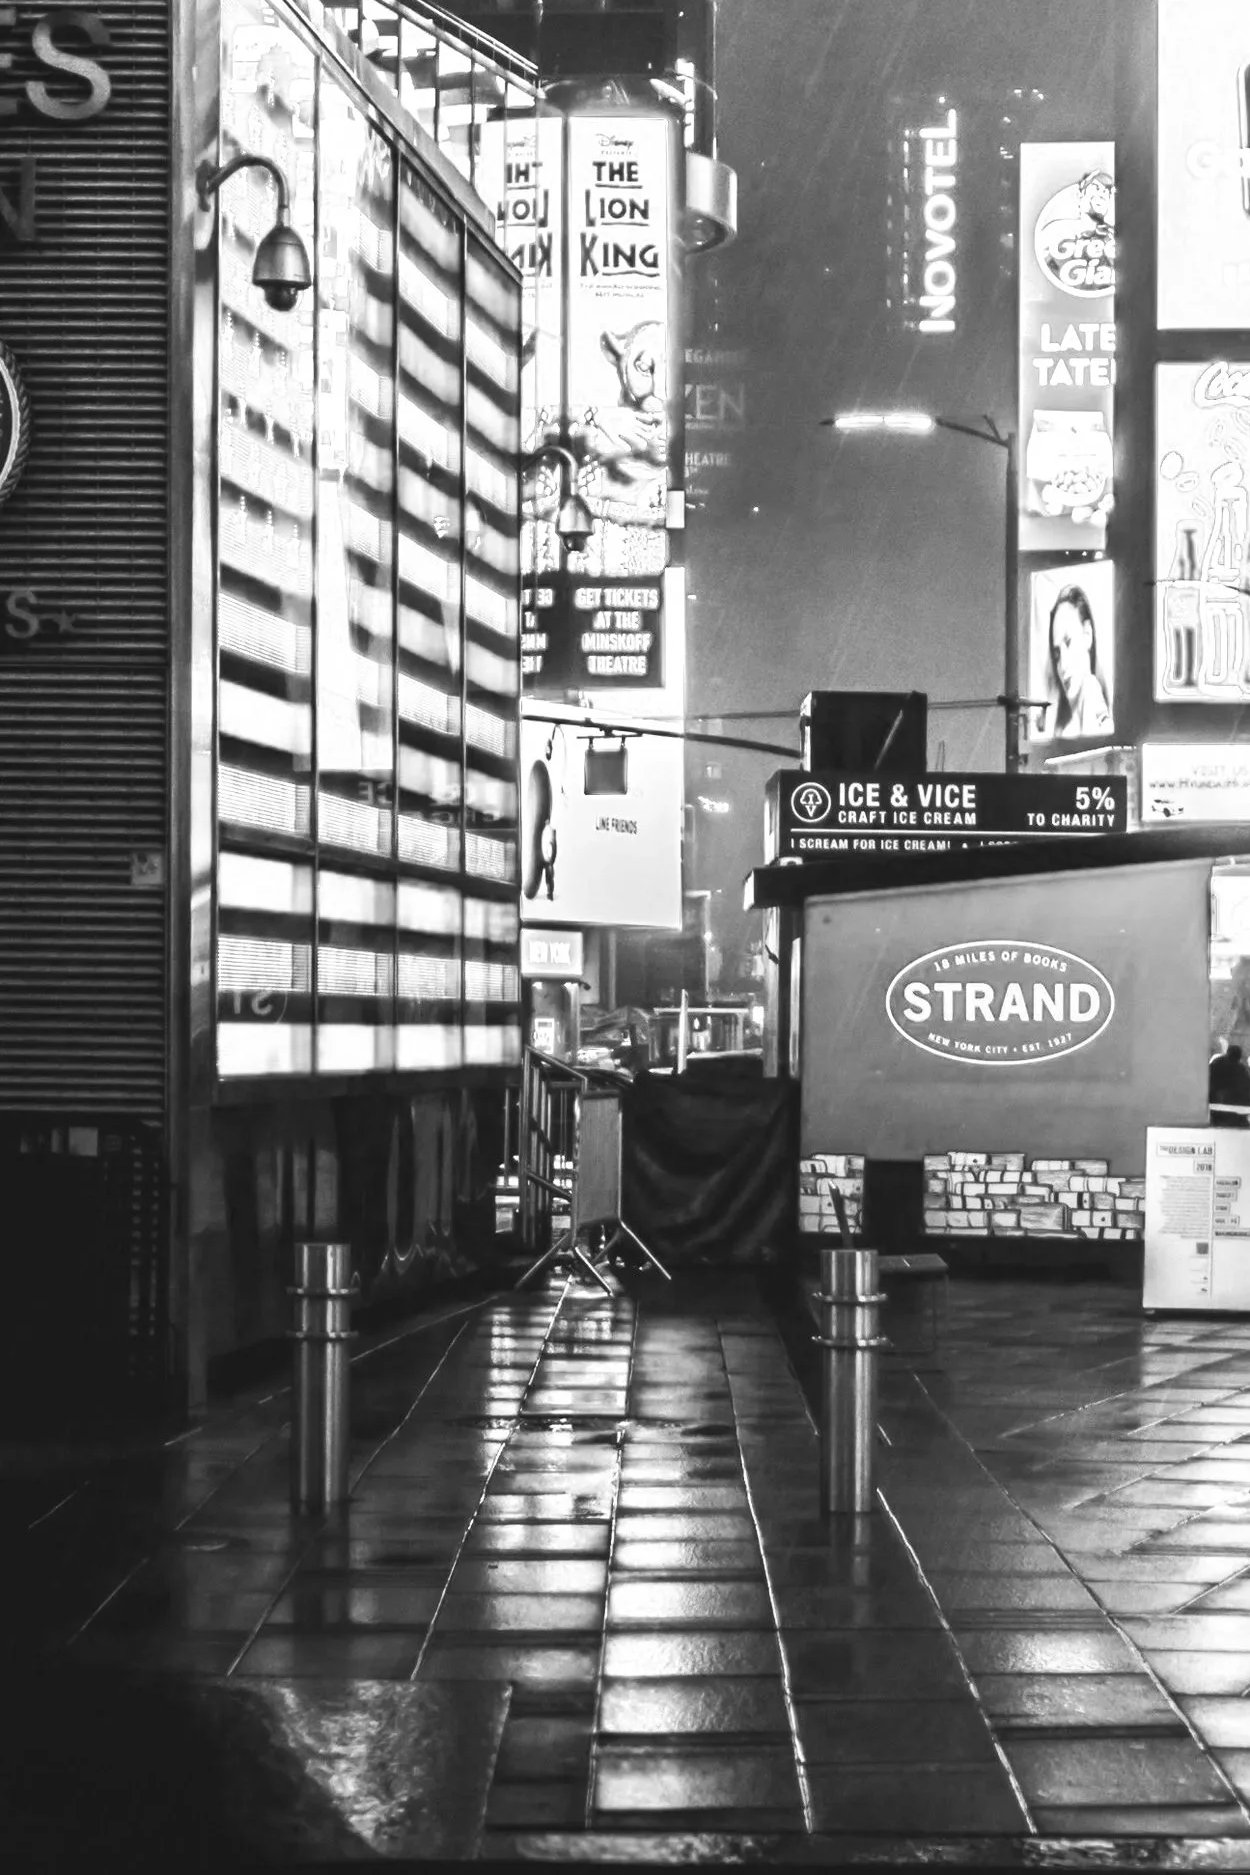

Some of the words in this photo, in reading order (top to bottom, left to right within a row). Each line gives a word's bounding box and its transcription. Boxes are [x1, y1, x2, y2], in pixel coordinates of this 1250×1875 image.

[592, 161, 638, 182] THE
[585, 189, 649, 227] LION
[919, 109, 956, 332] NOVOTEL
[580, 232, 660, 277] KING
[1049, 238, 1116, 259] Gree
[1060, 259, 1116, 286] Gia
[1041, 323, 1116, 352] LATE
[1032, 357, 1116, 386] TATE
[575, 588, 601, 609] GET
[604, 588, 659, 609] TICKETS
[593, 611, 611, 630] AT
[614, 611, 641, 630] THE
[581, 632, 651, 653] MINSKOFF
[588, 655, 647, 675] THEATRE
[838, 782, 880, 807] ICE
[890, 784, 909, 808] &
[917, 784, 977, 809] VICE
[1075, 786, 1116, 811] 5%
[838, 810, 887, 824] CRAFT
[893, 811, 917, 825] ICE
[923, 811, 977, 825] CREAM
[1027, 813, 1046, 826] TO
[1051, 813, 1116, 827] CHARITY
[799, 838, 849, 850] SCREAM
[853, 839, 876, 850] FOR
[880, 839, 899, 851] ICE
[904, 839, 951, 852] CREAM!
[934, 958, 950, 972] 18
[955, 951, 995, 967] MILES
[1001, 951, 1018, 962] OF
[1023, 952, 1068, 973] BOOKS
[903, 981, 1101, 1023] STRAND
[928, 1032, 950, 1047] NEW
[954, 1040, 981, 1053] YORK
[985, 1045, 1008, 1055] CITY
[1048, 1033, 1073, 1048] 1927
